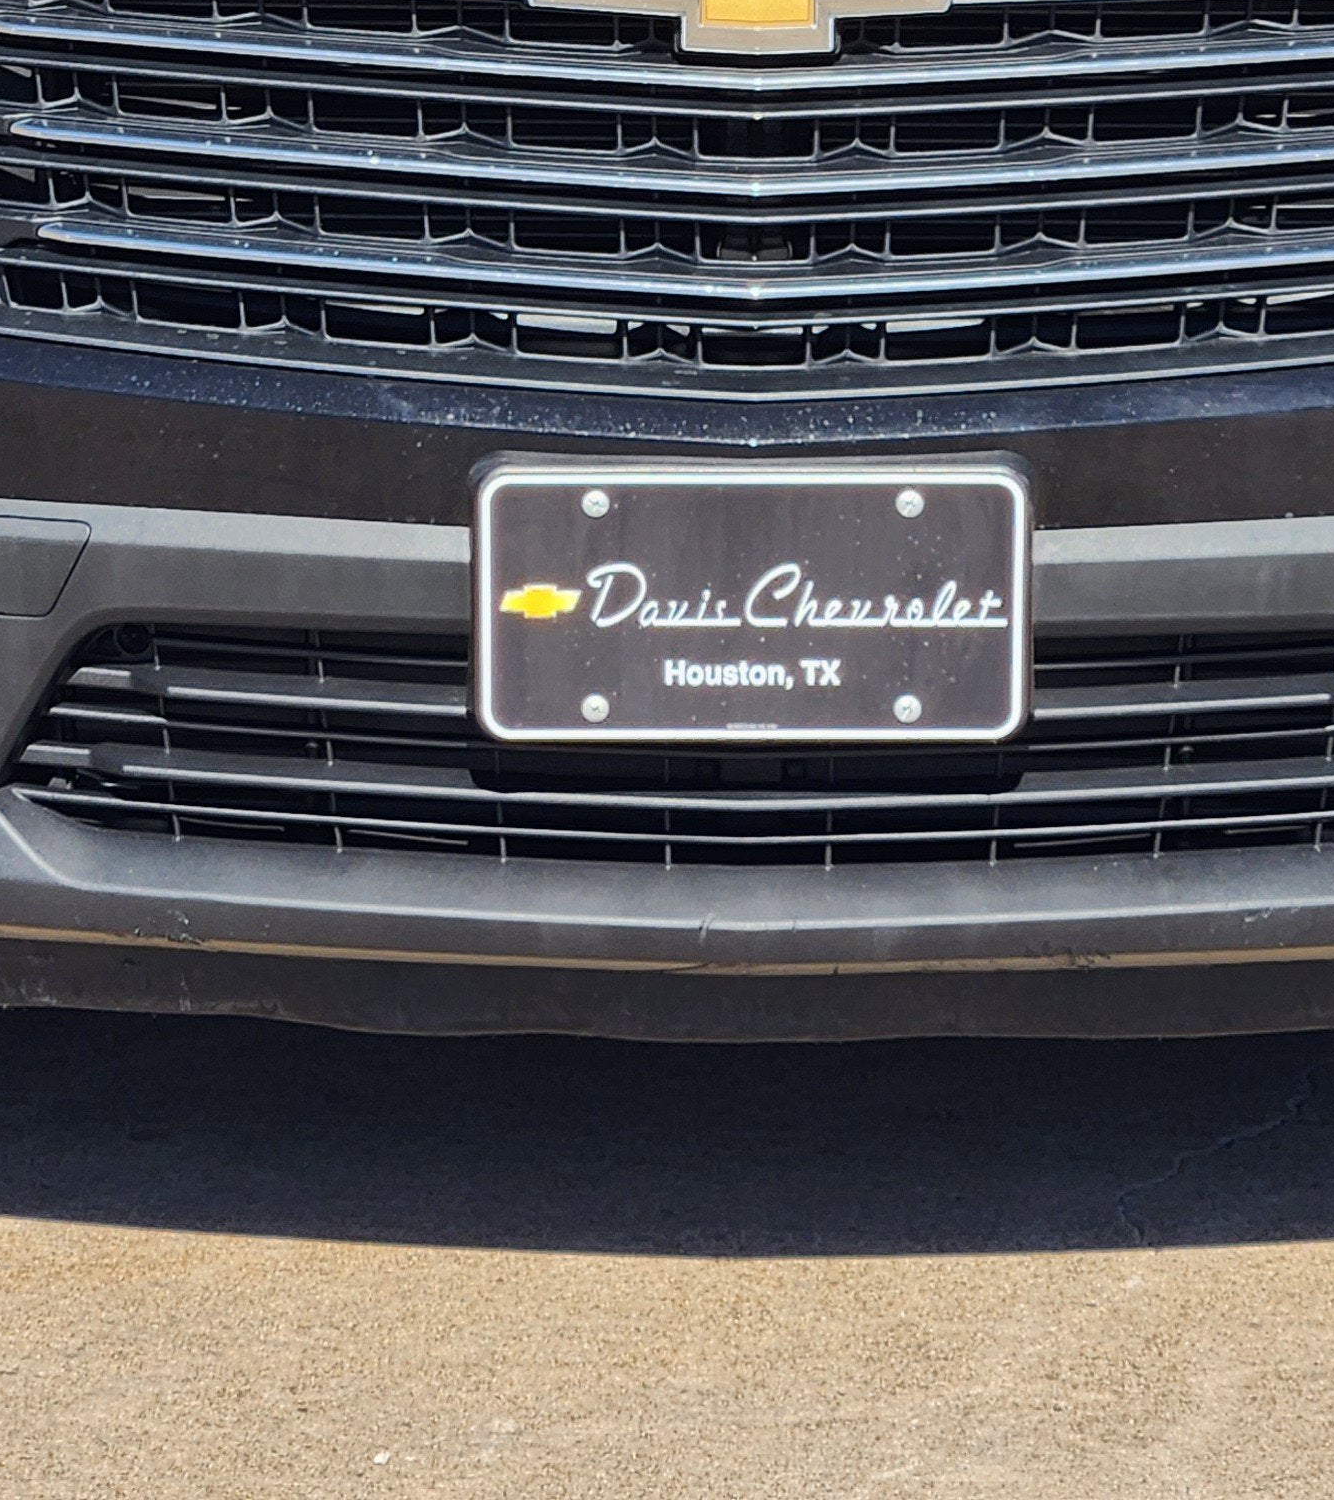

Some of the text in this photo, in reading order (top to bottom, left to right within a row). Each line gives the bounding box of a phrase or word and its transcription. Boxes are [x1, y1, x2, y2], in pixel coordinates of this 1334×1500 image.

[586, 562, 1009, 628] Davis Chevrolet
[664, 659, 842, 691] Houston, TX
